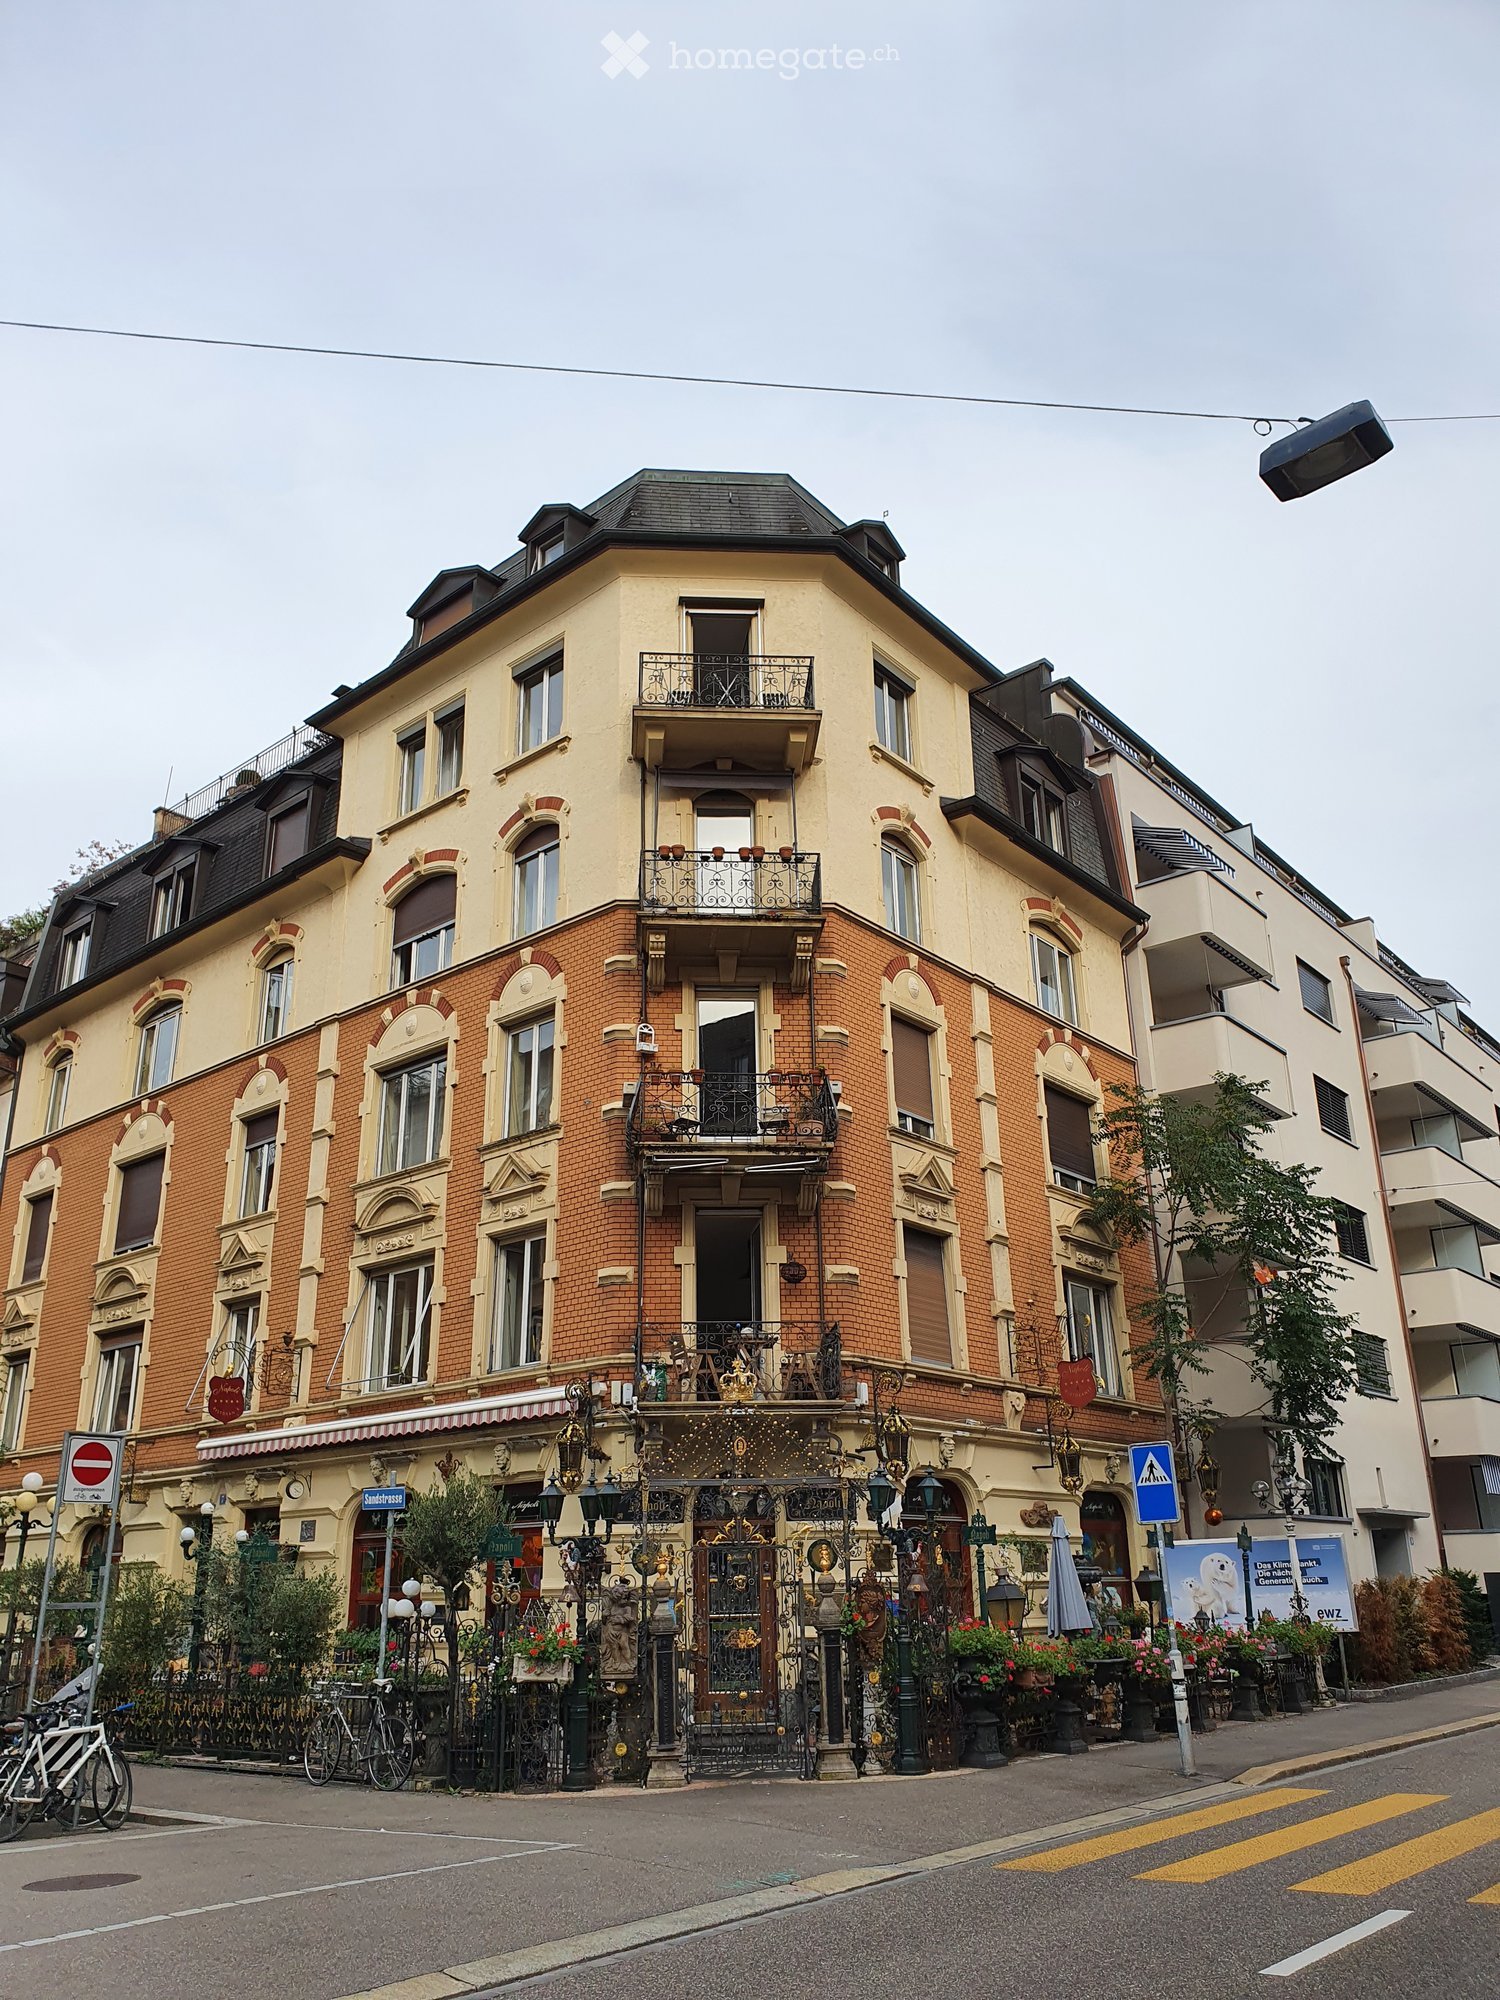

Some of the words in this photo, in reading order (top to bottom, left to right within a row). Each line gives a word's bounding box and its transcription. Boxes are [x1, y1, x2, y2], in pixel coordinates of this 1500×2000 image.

[212, 1383, 241, 1395] Napoli
[364, 1493, 403, 1505] Sandstrasse
[511, 1500, 540, 1512] Napoli
[488, 1541, 513, 1553] Napoli
[1302, 1576, 1323, 1584] auch.
[1317, 1608, 1342, 1619] ewz
